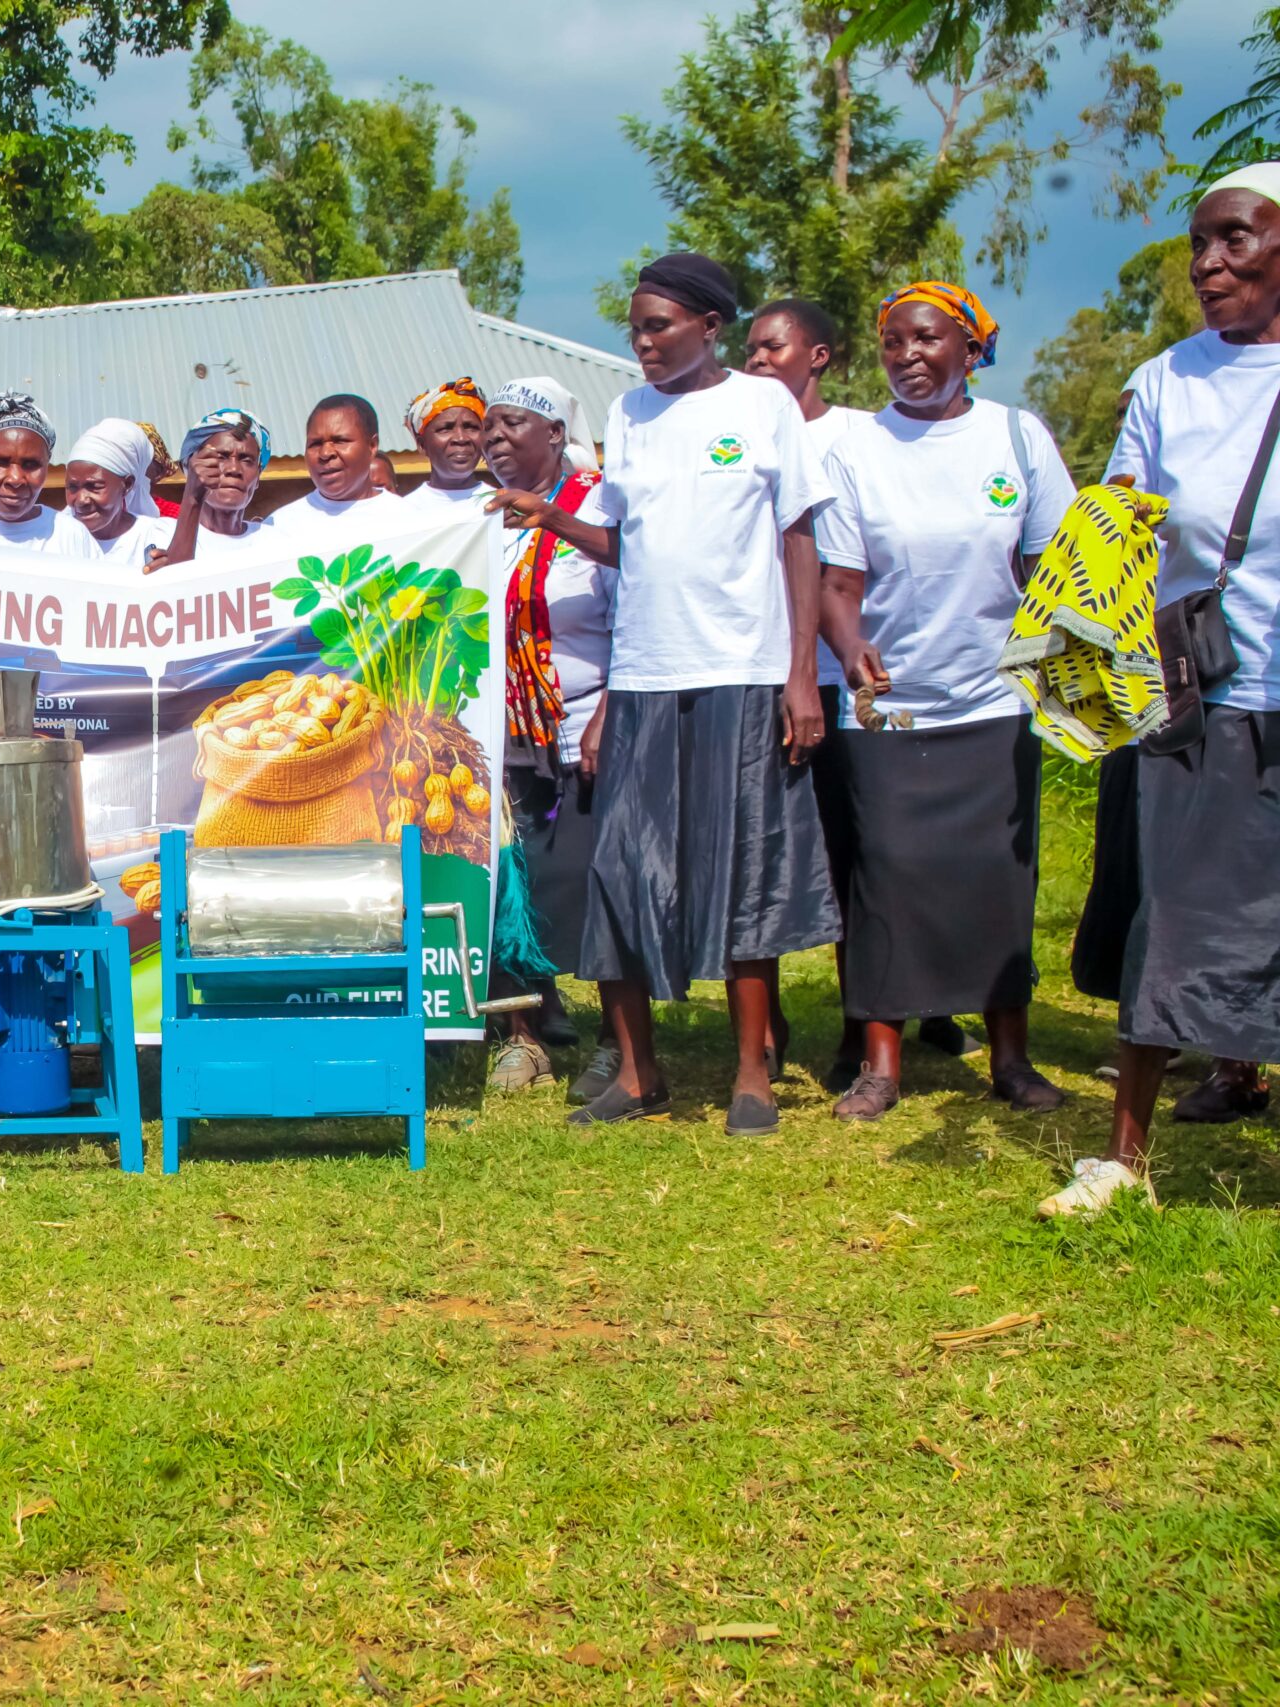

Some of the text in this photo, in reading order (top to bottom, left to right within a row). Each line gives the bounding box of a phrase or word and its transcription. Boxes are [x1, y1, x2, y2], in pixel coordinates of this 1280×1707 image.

[517, 386, 556, 412] MARY
[85, 581, 274, 649] MACHINE
[58, 697, 76, 710] BY
